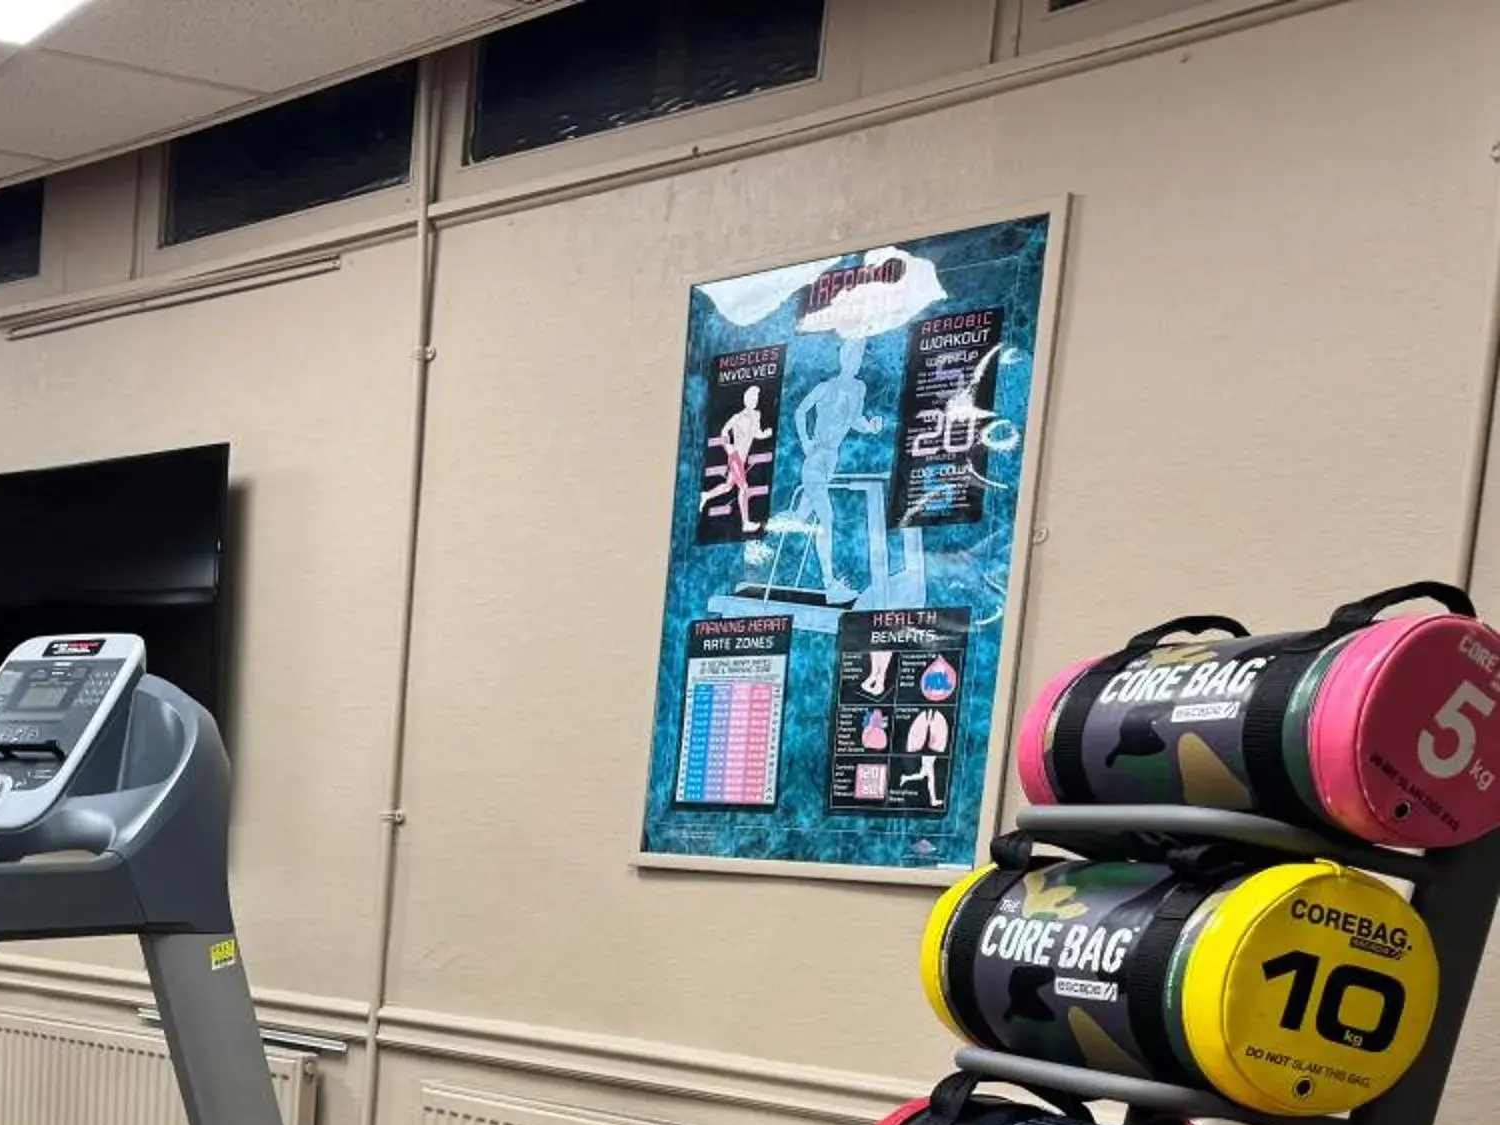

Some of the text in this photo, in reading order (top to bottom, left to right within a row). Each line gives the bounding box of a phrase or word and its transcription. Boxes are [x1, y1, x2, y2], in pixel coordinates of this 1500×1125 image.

[921, 312, 993, 334] AEROBIC
[920, 328, 991, 350] WORKOUT
[719, 349, 780, 369] MUSCLES
[718, 364, 778, 384] INVOLVED
[873, 611, 937, 627] HEALTH
[703, 635, 776, 651] RATE ZONES
[870, 628, 937, 644] BENEFITS
[1100, 657, 1268, 704] CORE BAG
[1417, 680, 1497, 779] 5
[1468, 758, 1496, 791] kg
[980, 915, 1133, 974] CORE BAG
[1261, 949, 1406, 1053] 10
[1343, 1029, 1363, 1048] kg
[1246, 1045, 1263, 1058] DO
[1265, 1051, 1291, 1067] NOT
